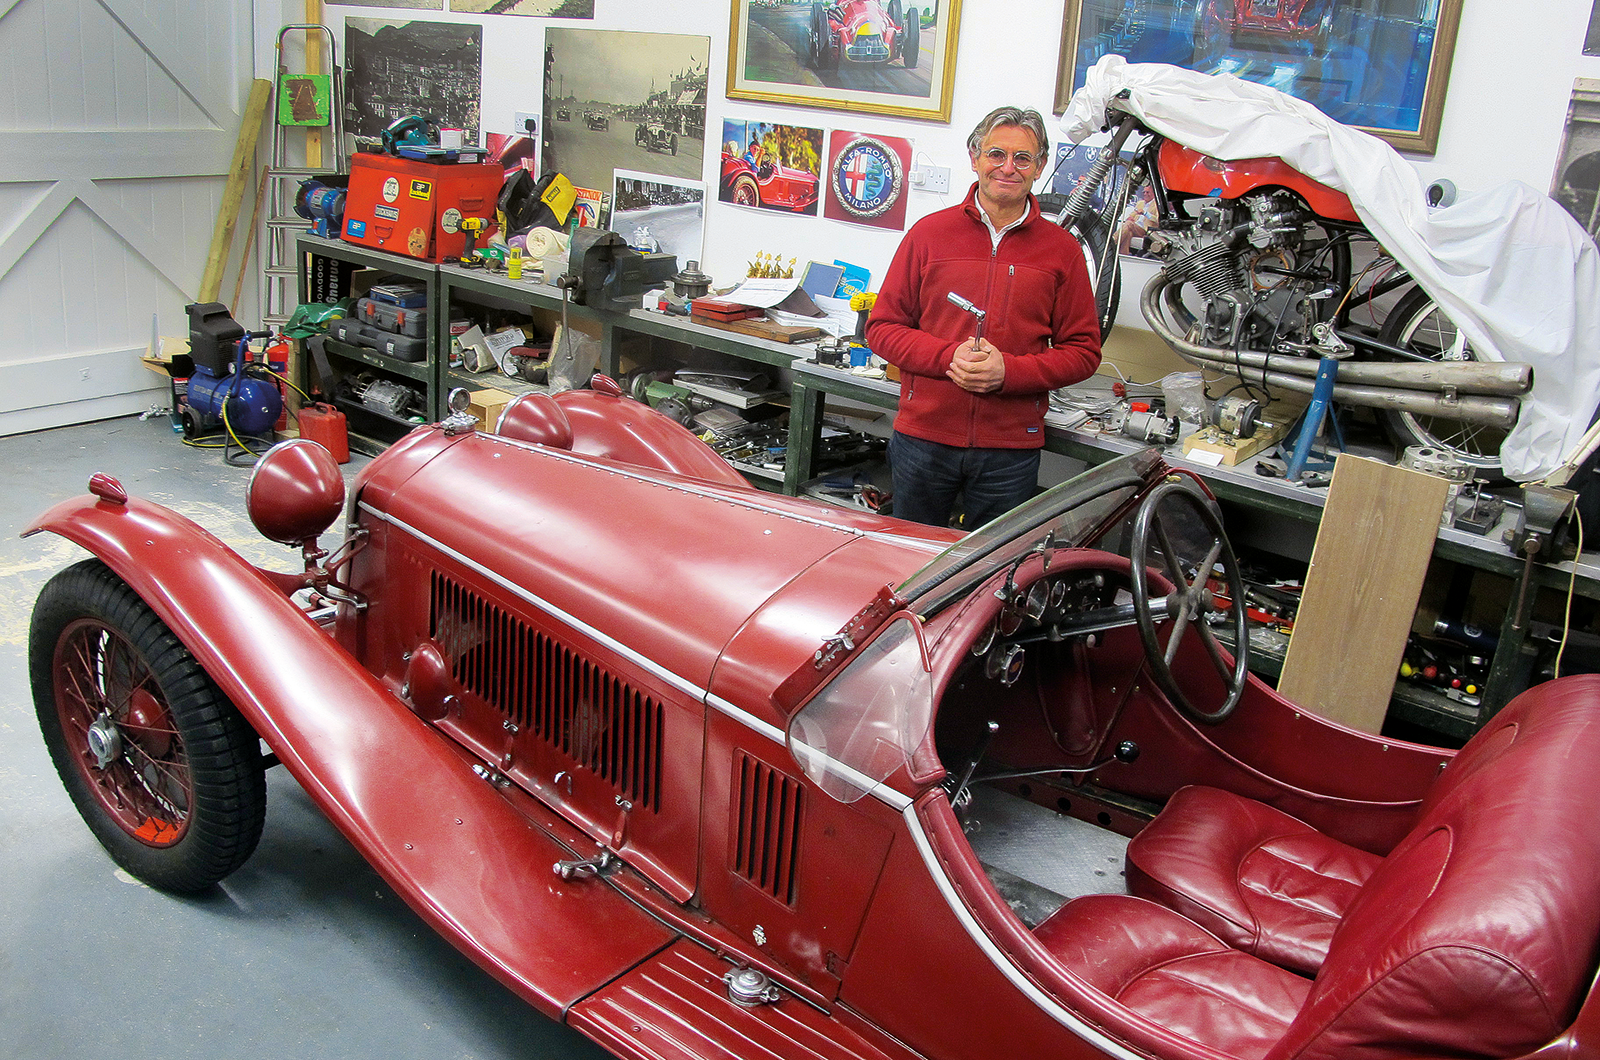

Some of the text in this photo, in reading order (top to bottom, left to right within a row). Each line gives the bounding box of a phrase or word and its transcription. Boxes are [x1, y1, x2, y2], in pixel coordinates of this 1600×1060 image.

[841, 147, 892, 178] ALFA-ROMEO
[844, 192, 881, 209] MILANO
[326, 258, 339, 303] onnaug
